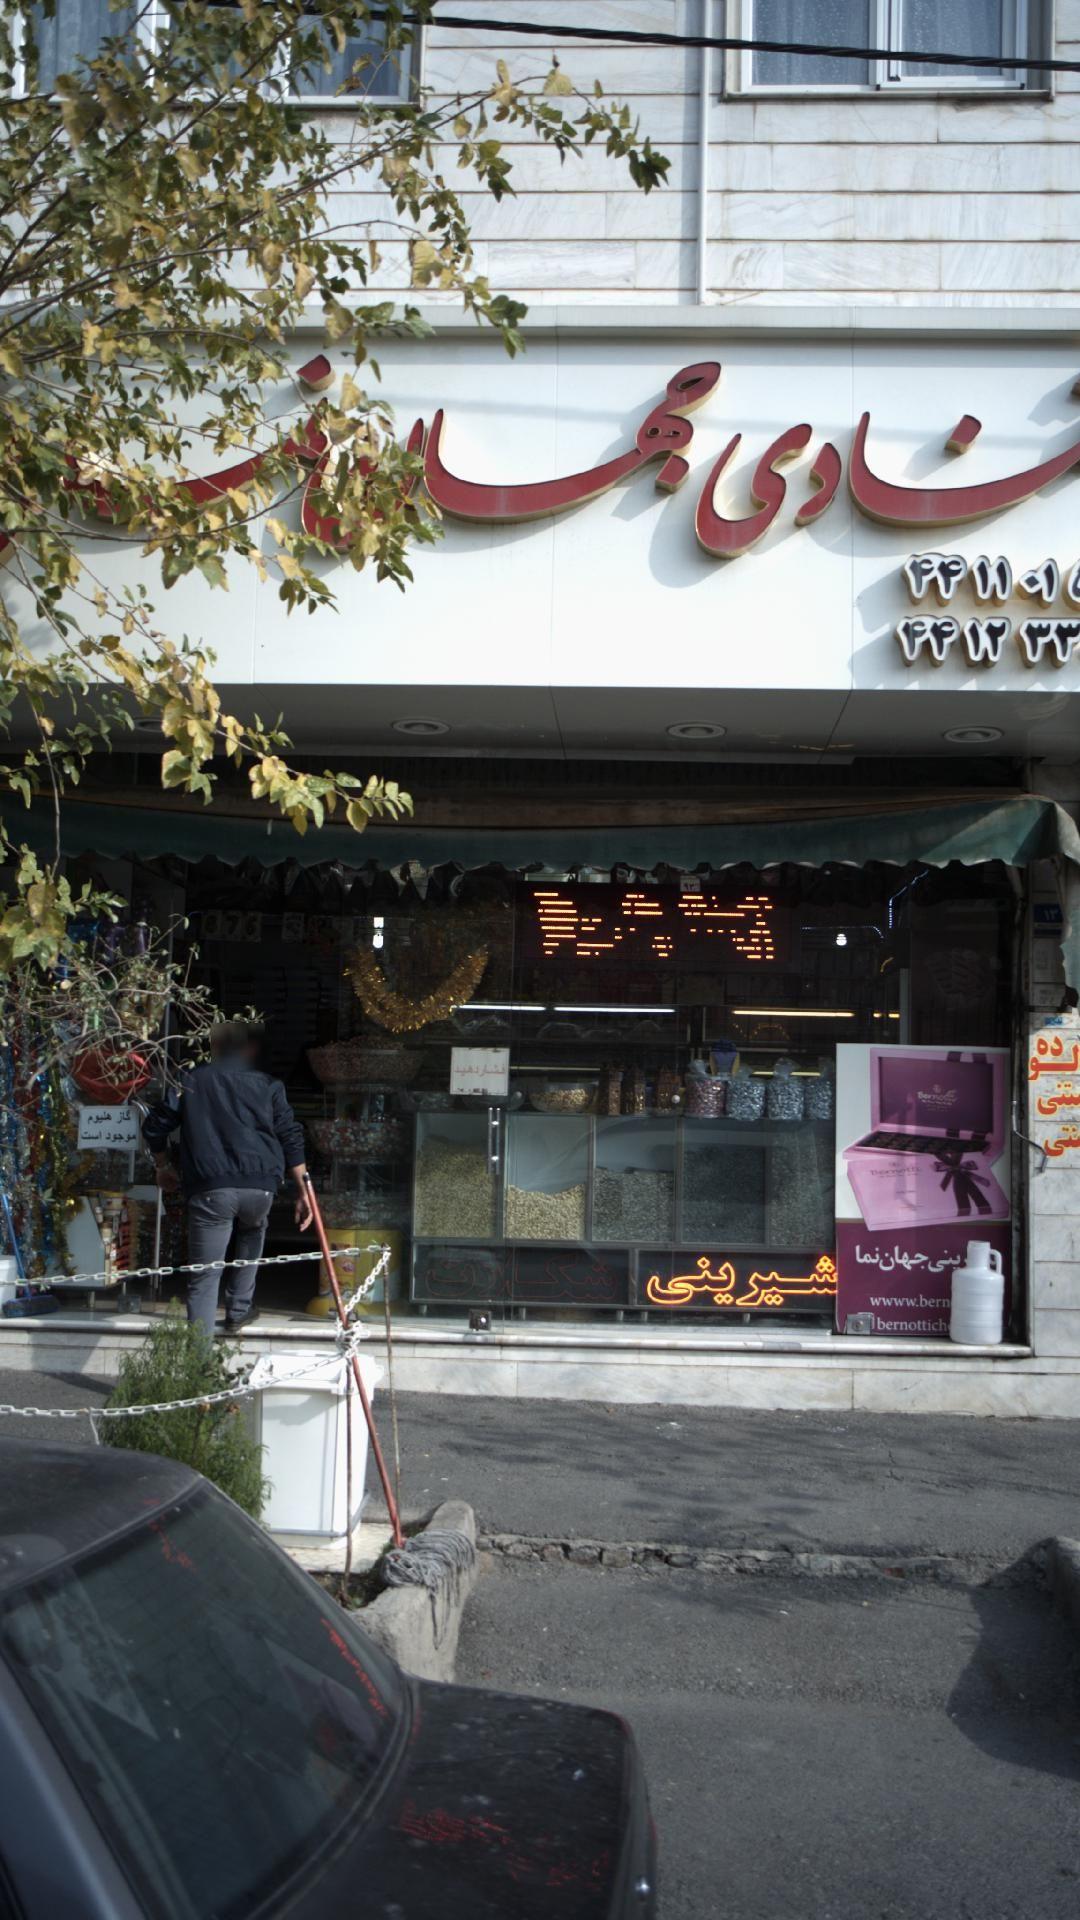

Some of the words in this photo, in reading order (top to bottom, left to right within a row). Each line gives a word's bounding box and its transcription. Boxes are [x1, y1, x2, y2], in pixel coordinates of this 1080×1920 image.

[696, 380, 1080, 558] نادی
[87, 1111, 112, 1124] هلیوم
[116, 1110, 131, 1124] گاز
[81, 1131, 102, 1140] است
[105, 1132, 136, 1143] موجود
[646, 1255, 838, 1306] شیرینی
[877, 1316, 951, 1331] bernottich
